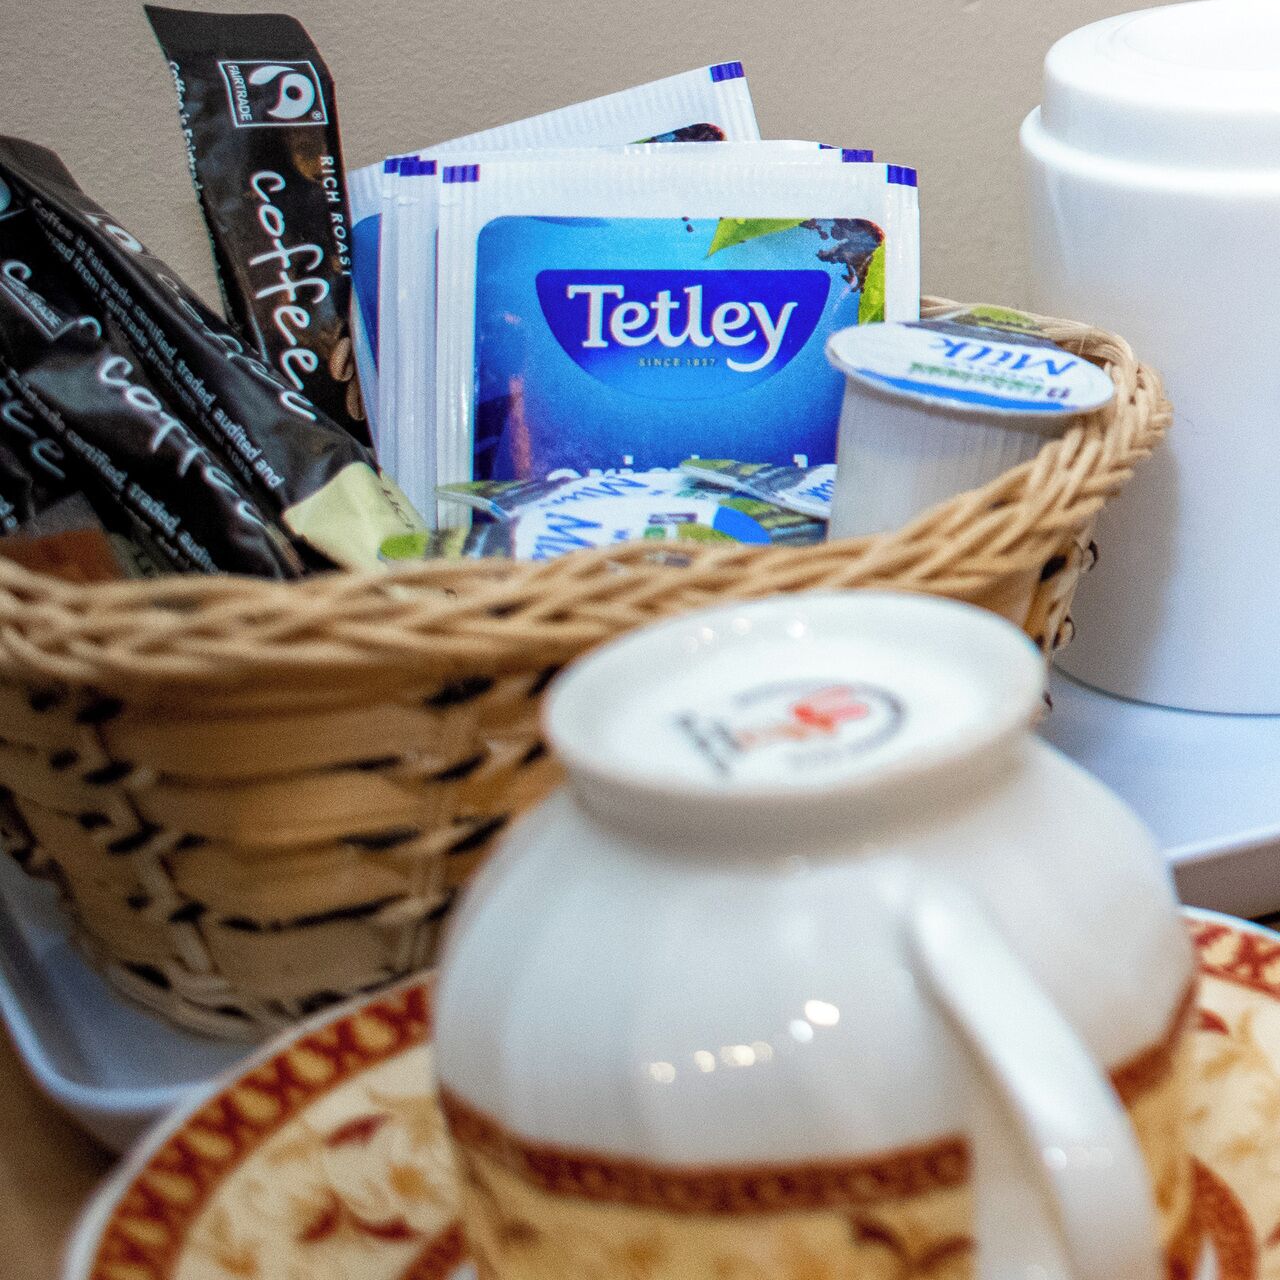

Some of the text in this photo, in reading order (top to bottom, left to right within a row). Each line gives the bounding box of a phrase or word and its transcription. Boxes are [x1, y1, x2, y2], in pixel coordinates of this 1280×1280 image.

[227, 65, 252, 121] FAIRTRADE
[320, 155, 341, 203] RICH
[71, 256, 102, 293] from
[250, 170, 331, 391] coffee
[565, 283, 799, 373] Tetley
[638, 357, 682, 368] SINCE
[930, 336, 1078, 377] Milk
[211, 403, 262, 462] audited
[252, 456, 283, 490] and
